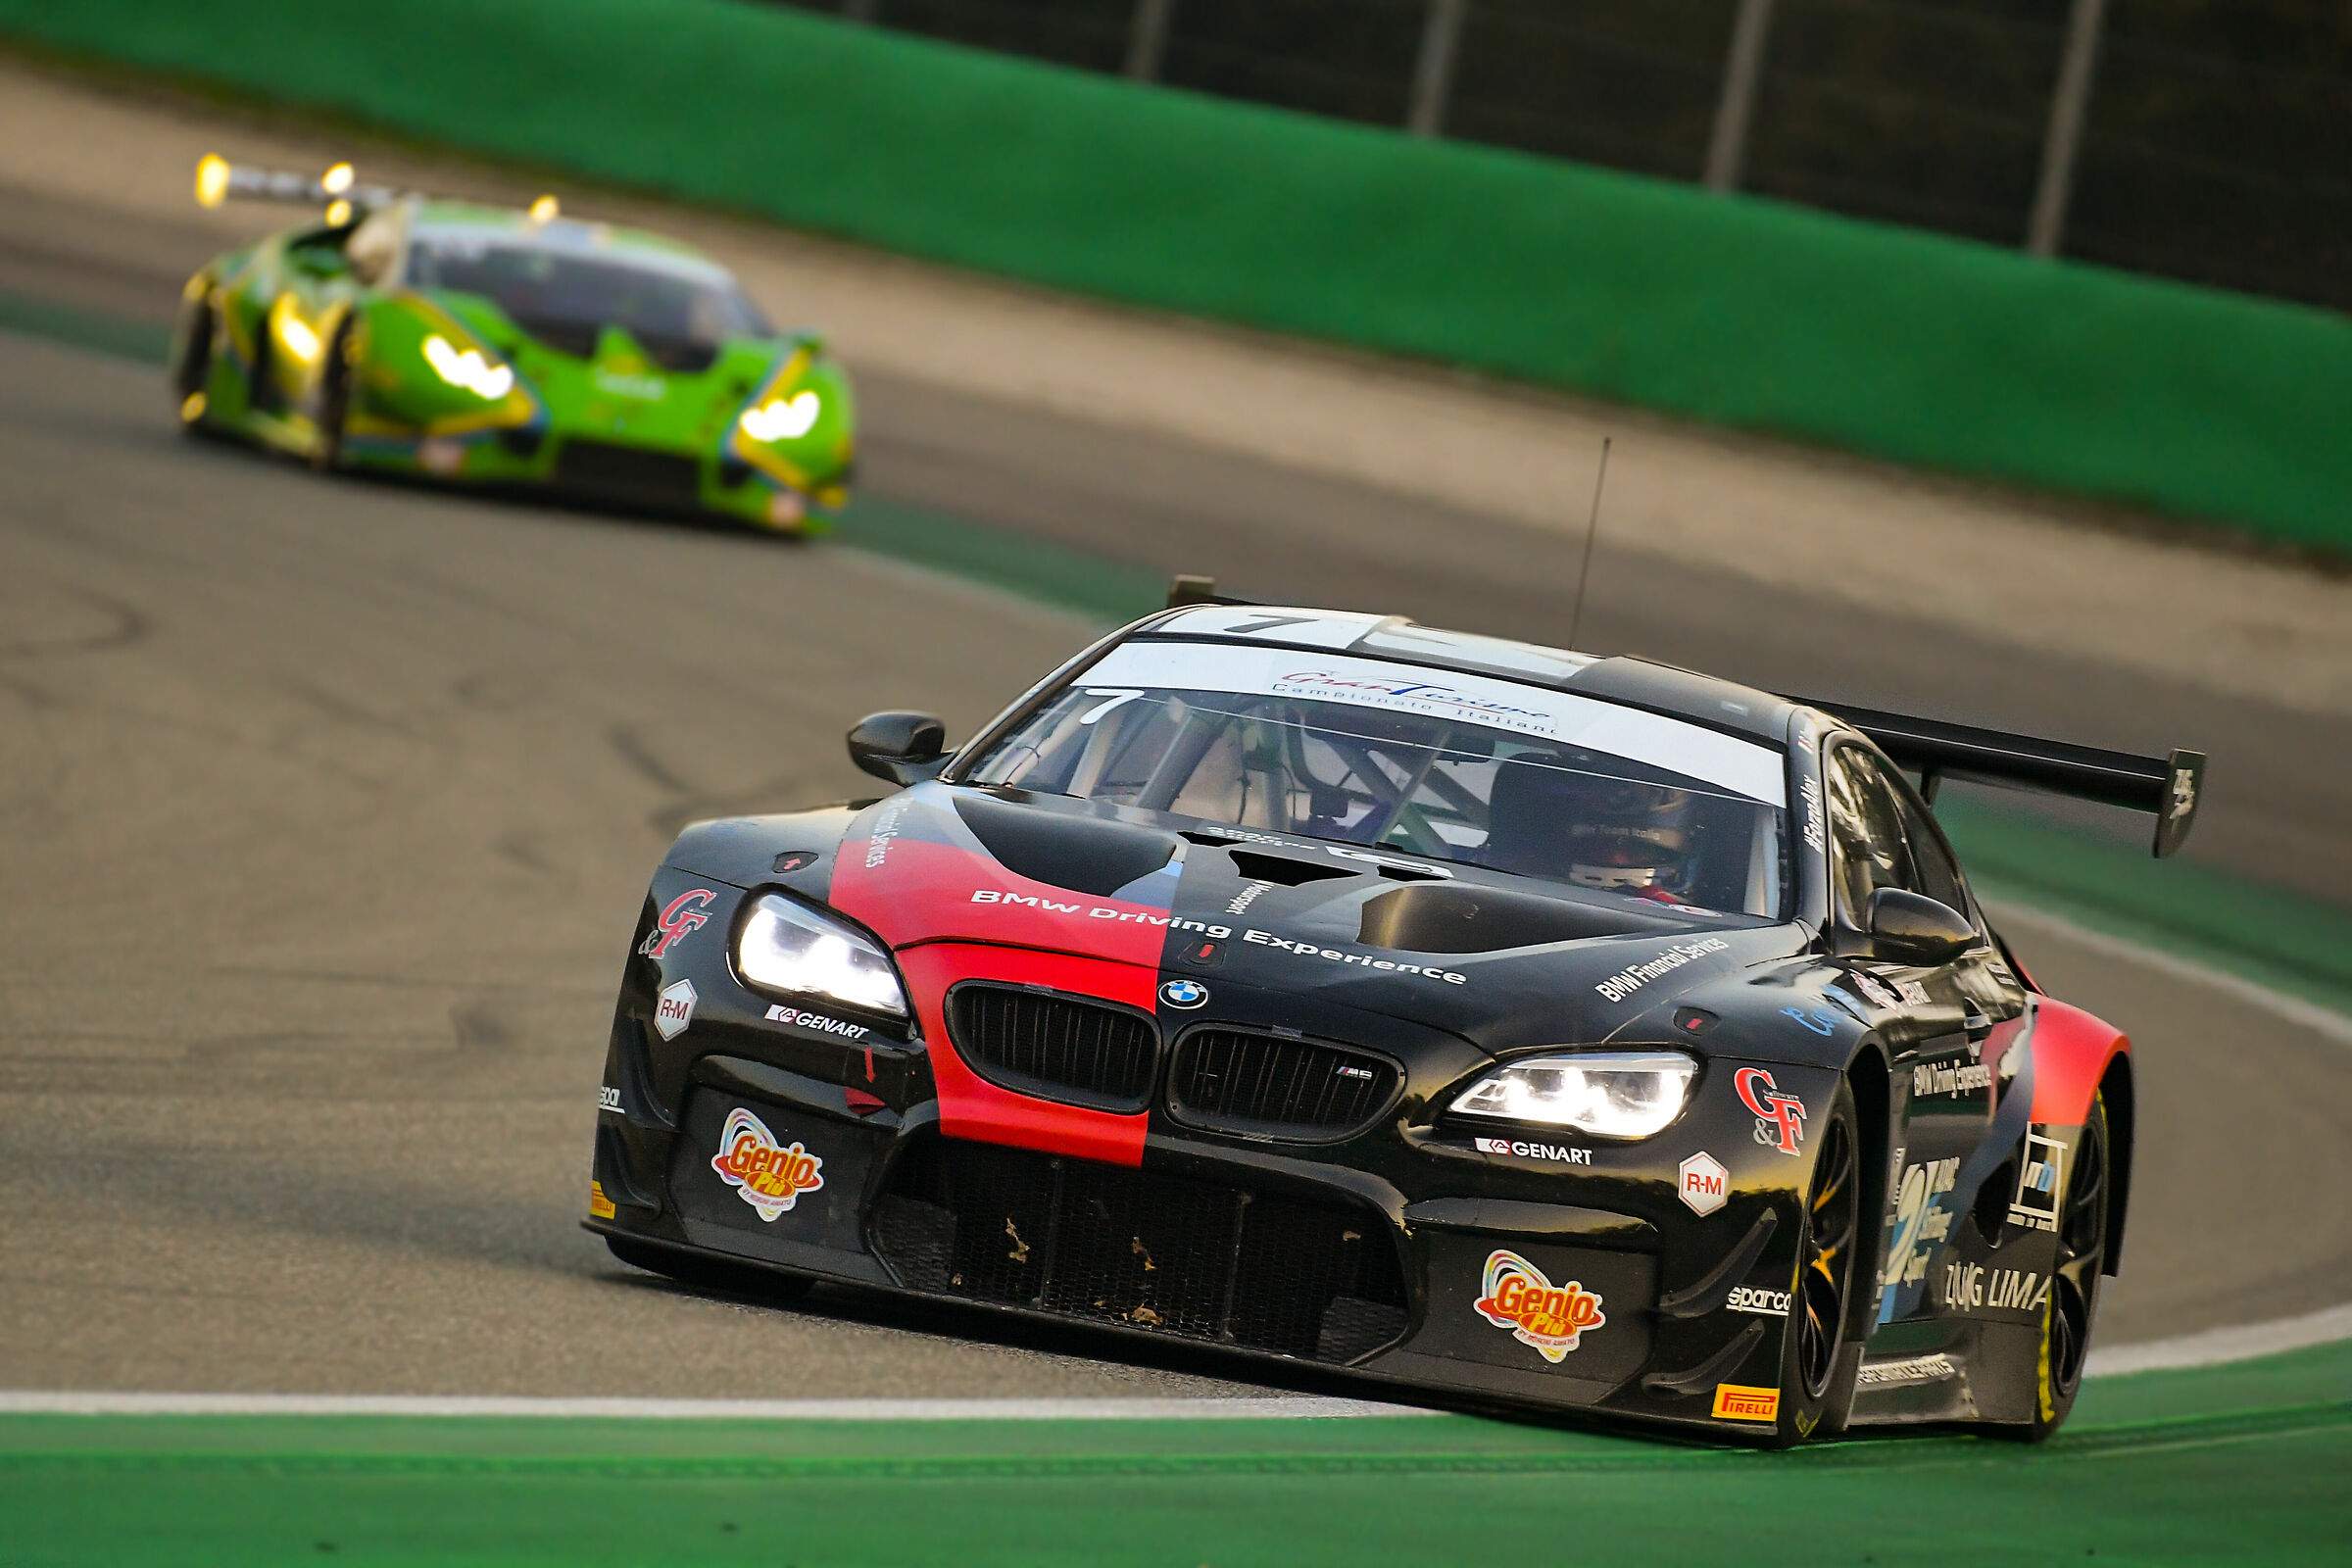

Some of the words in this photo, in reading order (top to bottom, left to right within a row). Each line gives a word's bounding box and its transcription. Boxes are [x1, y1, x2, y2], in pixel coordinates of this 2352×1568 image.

[1223, 614, 1320, 633] 7
[1079, 688, 1145, 725] 7
[1272, 683, 1433, 710] Campionato
[970, 890, 1081, 913] BMW
[1089, 907, 1232, 939] Driving
[1242, 929, 1467, 985] Experience
[1594, 968, 1640, 1003] BMW
[1630, 948, 1687, 983] Financial
[1677, 937, 1730, 960] Services
[660, 998, 689, 1021] R-M
[795, 1011, 870, 1040] GENART
[730, 1135, 815, 1188] Genio
[1511, 1141, 1592, 1166] GENART
[1686, 1173, 1724, 1196] R-M
[1494, 1275, 1595, 1325] Genio
[1728, 1286, 1791, 1312] sparco
[1721, 1393, 1776, 1415] PIRELLI
